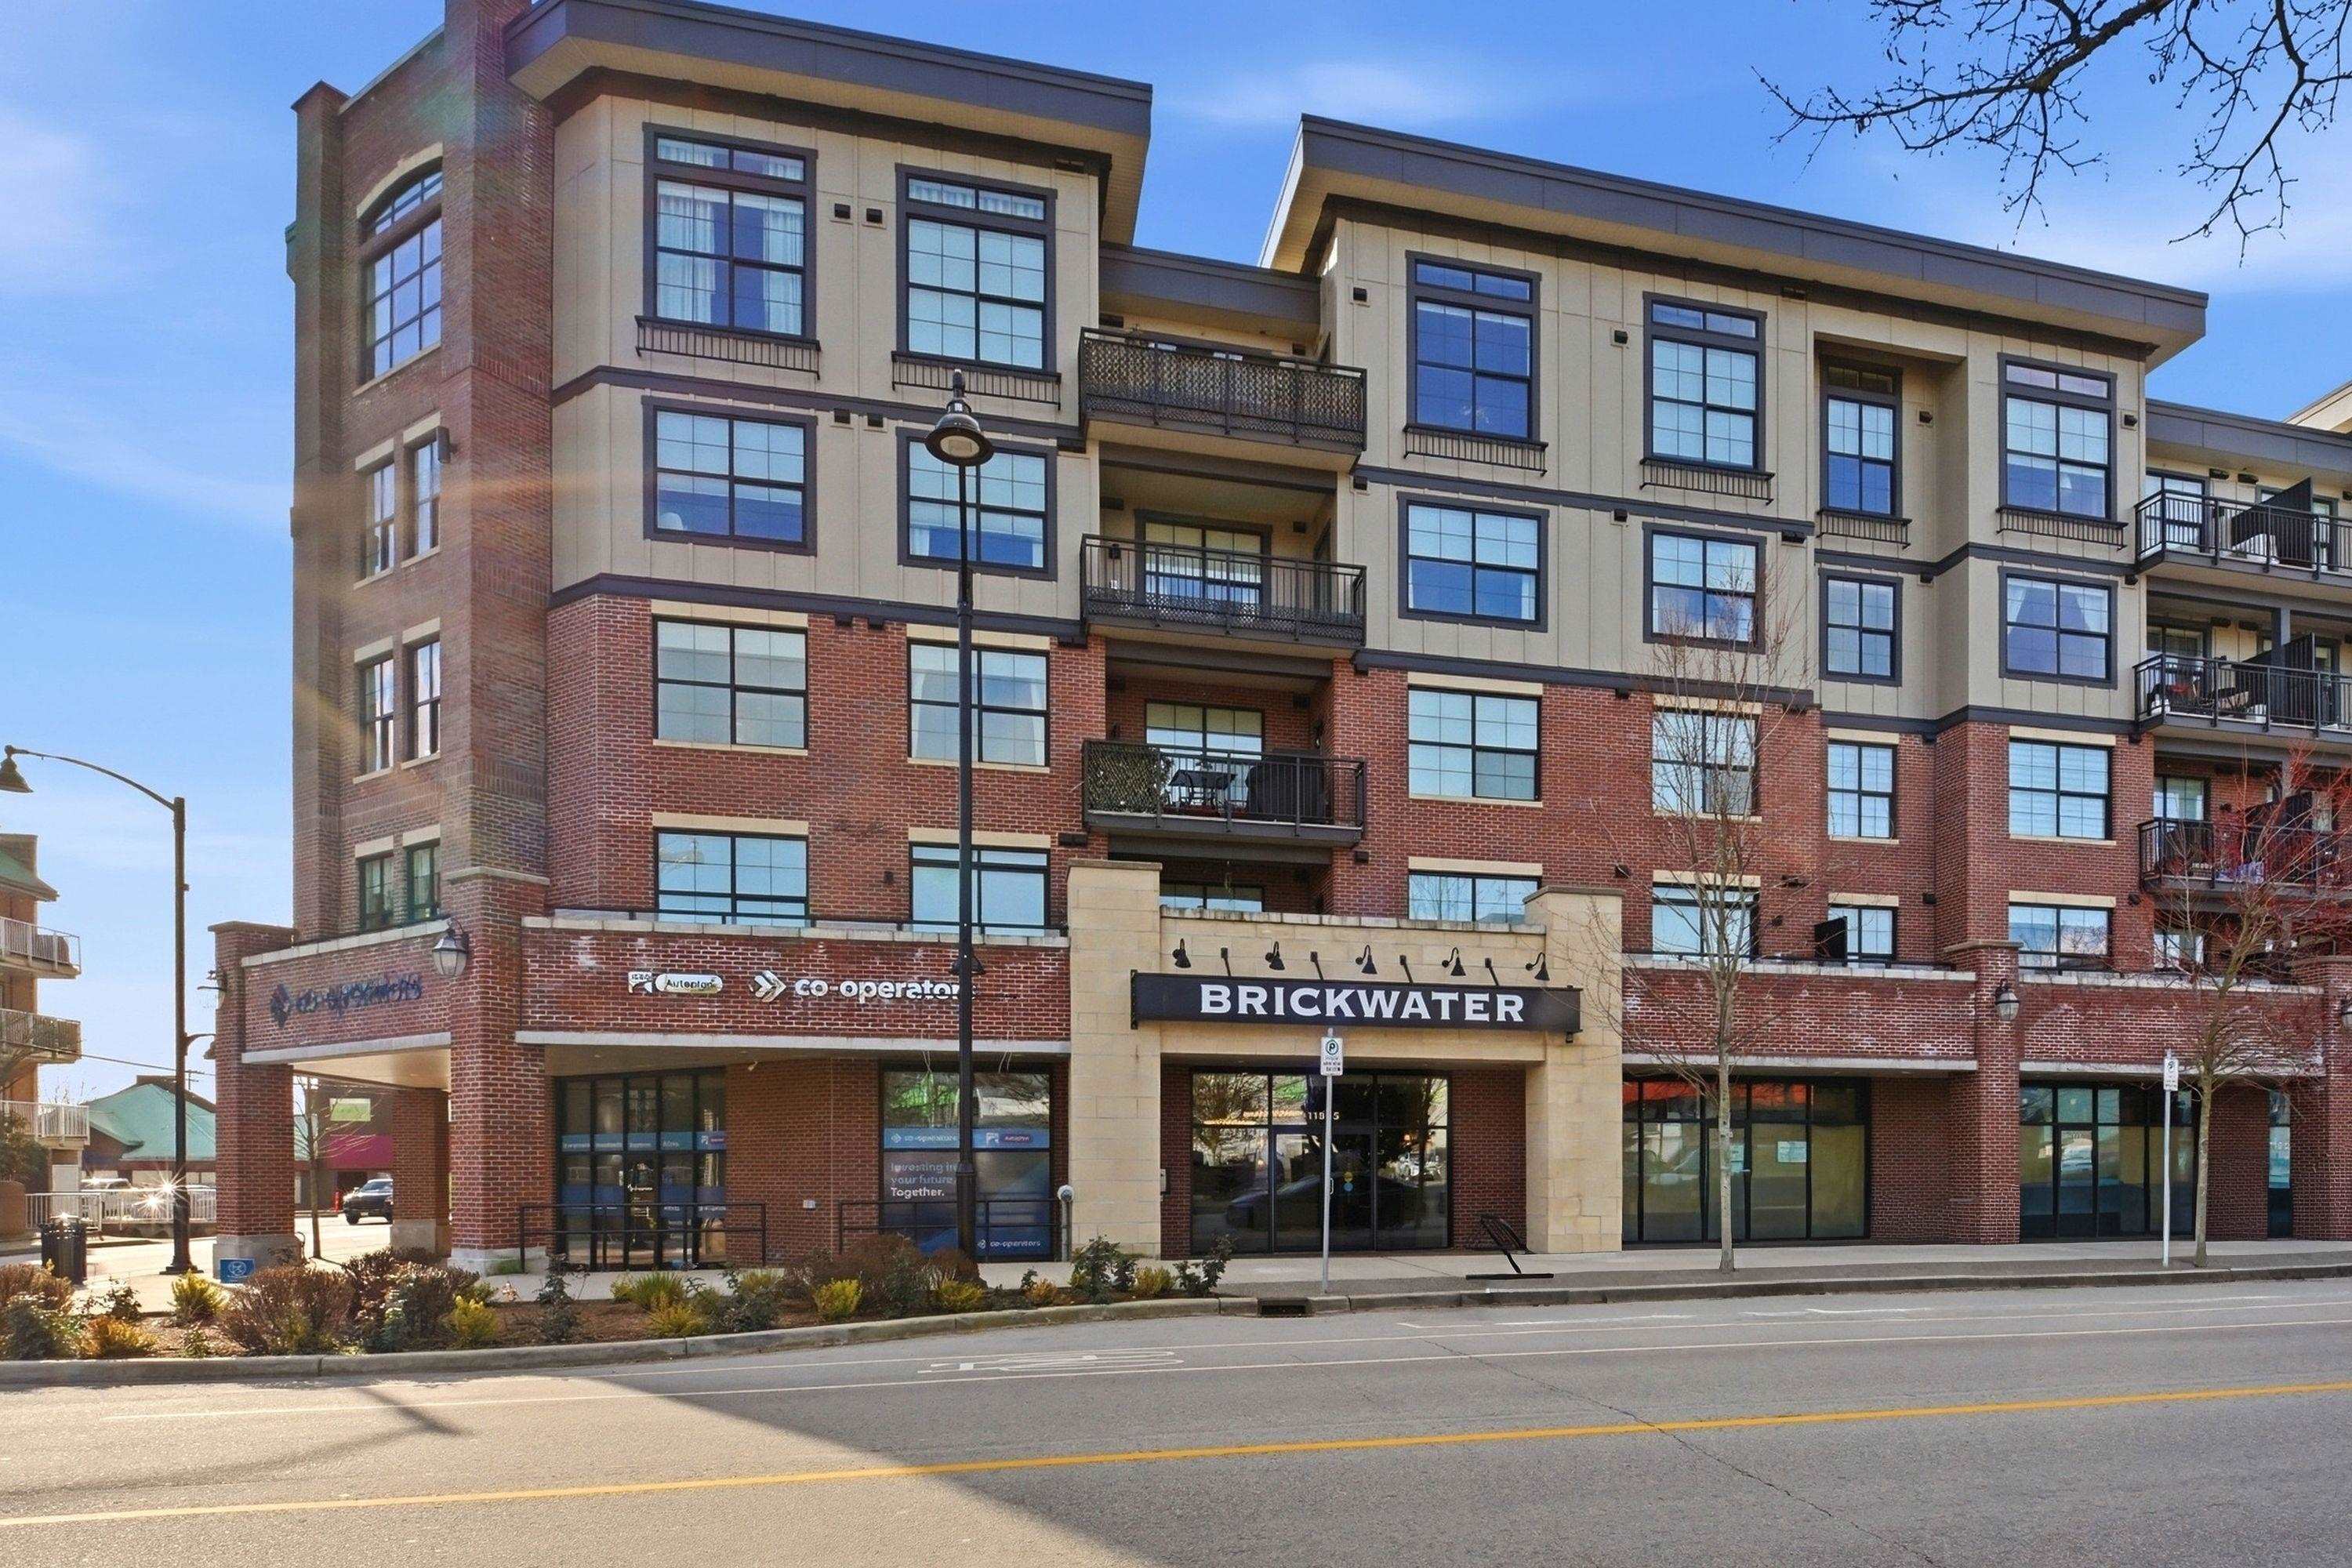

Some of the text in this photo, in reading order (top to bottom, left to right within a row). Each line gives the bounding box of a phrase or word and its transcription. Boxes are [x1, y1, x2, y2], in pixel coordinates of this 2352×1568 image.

[794, 978, 975, 1003] co-operator
[1200, 983, 1524, 1022] BRICKWATER
[891, 1187, 945, 1200] Together.
